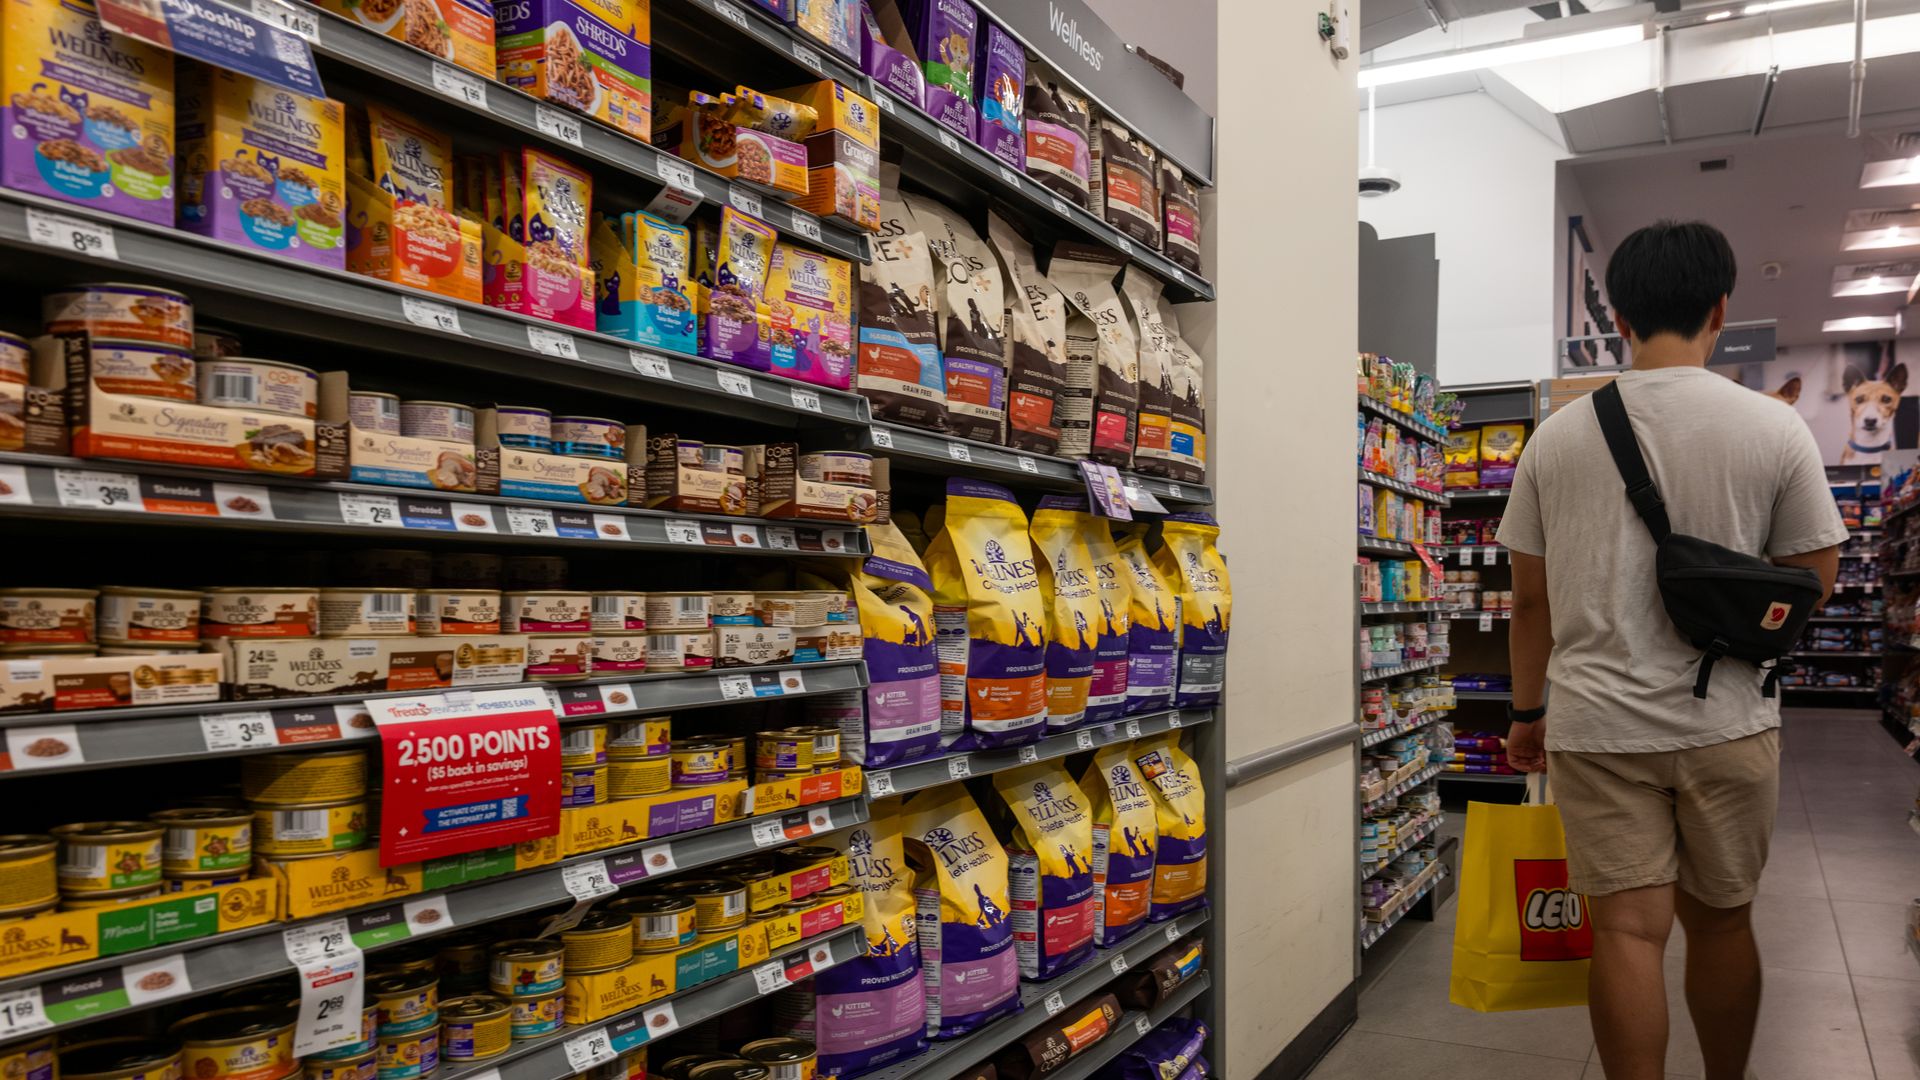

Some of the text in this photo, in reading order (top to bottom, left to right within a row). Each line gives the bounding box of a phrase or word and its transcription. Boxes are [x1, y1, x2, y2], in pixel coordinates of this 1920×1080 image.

[575, 15, 628, 58] SHREDS
[1050, 1, 1101, 71] Wellness
[48, 26, 145, 75] WELLNESS
[891, 63, 917, 87] WELLNESS
[247, 99, 322, 138] WELLNESS
[944, 104, 969, 125] WELLNESS
[997, 139, 1020, 156] WELLNESS
[385, 142, 445, 181] WELLNESS
[406, 231, 447, 251] Shredded
[408, 244, 432, 257] Chicken
[788, 267, 832, 290] WELLNESS
[658, 306, 680, 317] Flaked
[718, 317, 742, 328] Flaked
[955, 345, 978, 355] PROVEN
[1724, 345, 1752, 353] Merrick
[949, 362, 973, 372] HEALTHY
[902, 384, 932, 398] GRAIN FREE
[975, 408, 989, 416] GRAIN
[153, 407, 228, 431] Signature
[646, 437, 675, 451] CORE
[383, 441, 432, 461] Signature
[766, 446, 793, 458] CORE
[532, 457, 577, 476] Signature
[153, 485, 201, 497] Shredded
[408, 504, 443, 515] Shredded
[560, 516, 588, 525] Shredded
[970, 558, 1036, 581] WELLNES
[222, 604, 268, 613] WELLNESS
[720, 608, 740, 616] CORE
[16, 617, 54, 628] CORE
[227, 613, 262, 623] CORE
[472, 612, 497, 621] CORE
[549, 613, 575, 622] CORE
[152, 618, 183, 628] CORE
[726, 634, 734, 643] 24
[249, 650, 264, 663] 24
[616, 652, 638, 661] CORE
[748, 650, 770, 660] CORE
[289, 659, 343, 671] WELLNESS
[897, 666, 918, 674] PROVEN
[1006, 665, 1027, 673] PROVEN
[56, 678, 84, 686] ADULT
[296, 672, 337, 687] CORE
[886, 691, 906, 699] KITTEN
[476, 699, 536, 710] MEMBERS EARN
[1007, 717, 1035, 728] GRAIN FREE
[905, 725, 933, 736] GRAIN FREE
[398, 726, 550, 767] 2,500 POINTS
[427, 755, 528, 782] ($5 back in savings)
[756, 792, 785, 805] WELLNESS
[438, 807, 469, 818] ACTIVATE
[470, 804, 488, 813] OFFER
[451, 815, 483, 825] PETSMART
[484, 812, 497, 820] APP
[651, 815, 676, 827] Minced
[573, 825, 615, 842] WELLNESS
[615, 856, 634, 865] Minced
[309, 877, 374, 899] WELLNESS
[156, 910, 179, 921] Turkey
[1525, 889, 1583, 930] LEGO
[362, 912, 391, 925] Minced
[103, 921, 148, 940] Minced
[980, 945, 1001, 954] PROVEN
[678, 960, 701, 974] Minced
[966, 967, 989, 976] KITTEN
[62, 977, 104, 995] Minced
[861, 975, 891, 986] PROVEN
[600, 984, 642, 1004] WELLNESS
[845, 1002, 871, 1010] KITTEN
[616, 1019, 636, 1032] Minced
[1042, 1040, 1069, 1060] WELLNESS
[224, 1050, 271, 1067] WELLNESS
